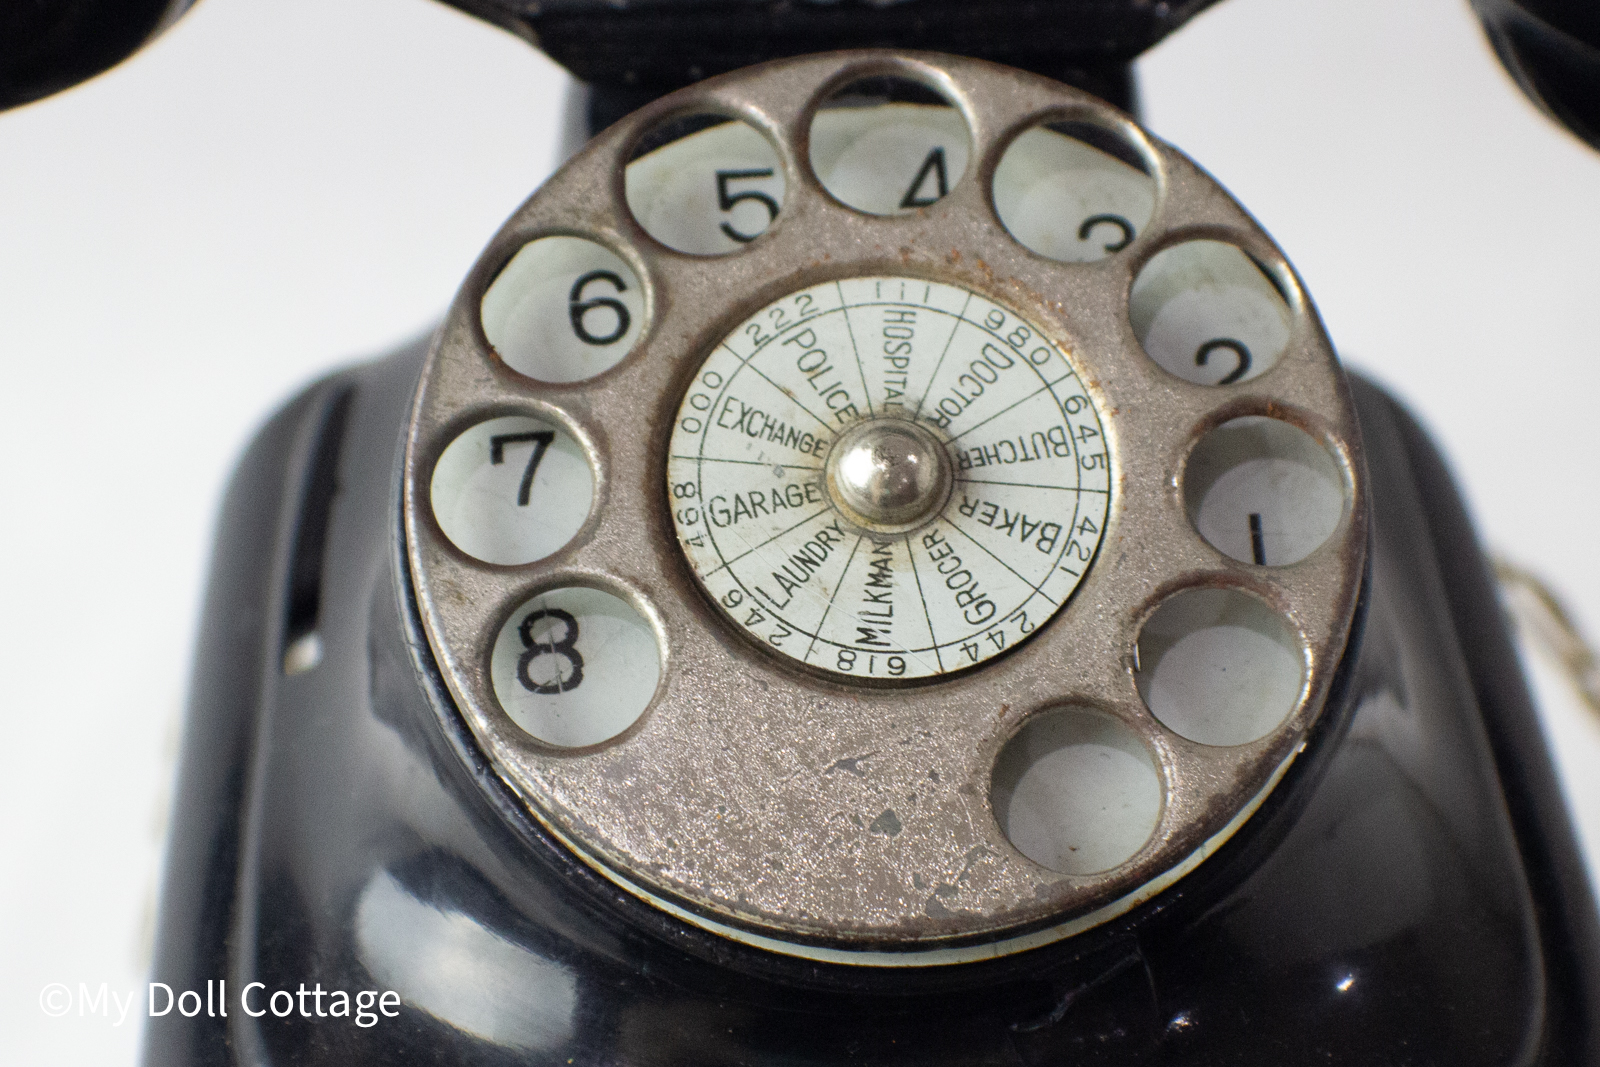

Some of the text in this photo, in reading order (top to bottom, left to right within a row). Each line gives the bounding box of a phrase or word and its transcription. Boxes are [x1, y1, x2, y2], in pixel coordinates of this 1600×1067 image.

[715, 167, 780, 243] 5
[900, 146, 949, 209] 4
[568, 269, 631, 346] 6
[745, 294, 819, 346] 222
[984, 308, 1051, 365] 980
[781, 327, 860, 424] POLICE
[883, 309, 917, 413] HOSPITAL
[926, 342, 1016, 430] DOCTOR
[681, 370, 723, 434] 000
[716, 395, 830, 460] EXCHANGE
[1064, 393, 1106, 471] 645
[490, 430, 555, 506] 7
[956, 425, 1071, 471] BUTCHER
[673, 481, 705, 548] 468
[709, 481, 822, 528] GARAGE
[958, 494, 1063, 555] BAKER
[755, 518, 846, 611] LAUNDRY
[922, 528, 997, 626] GROCER
[1060, 515, 1098, 577] 421
[720, 588, 793, 647] 246
[855, 539, 894, 647] MILKMAN
[516, 607, 584, 695] 8
[959, 610, 1036, 663] 244
